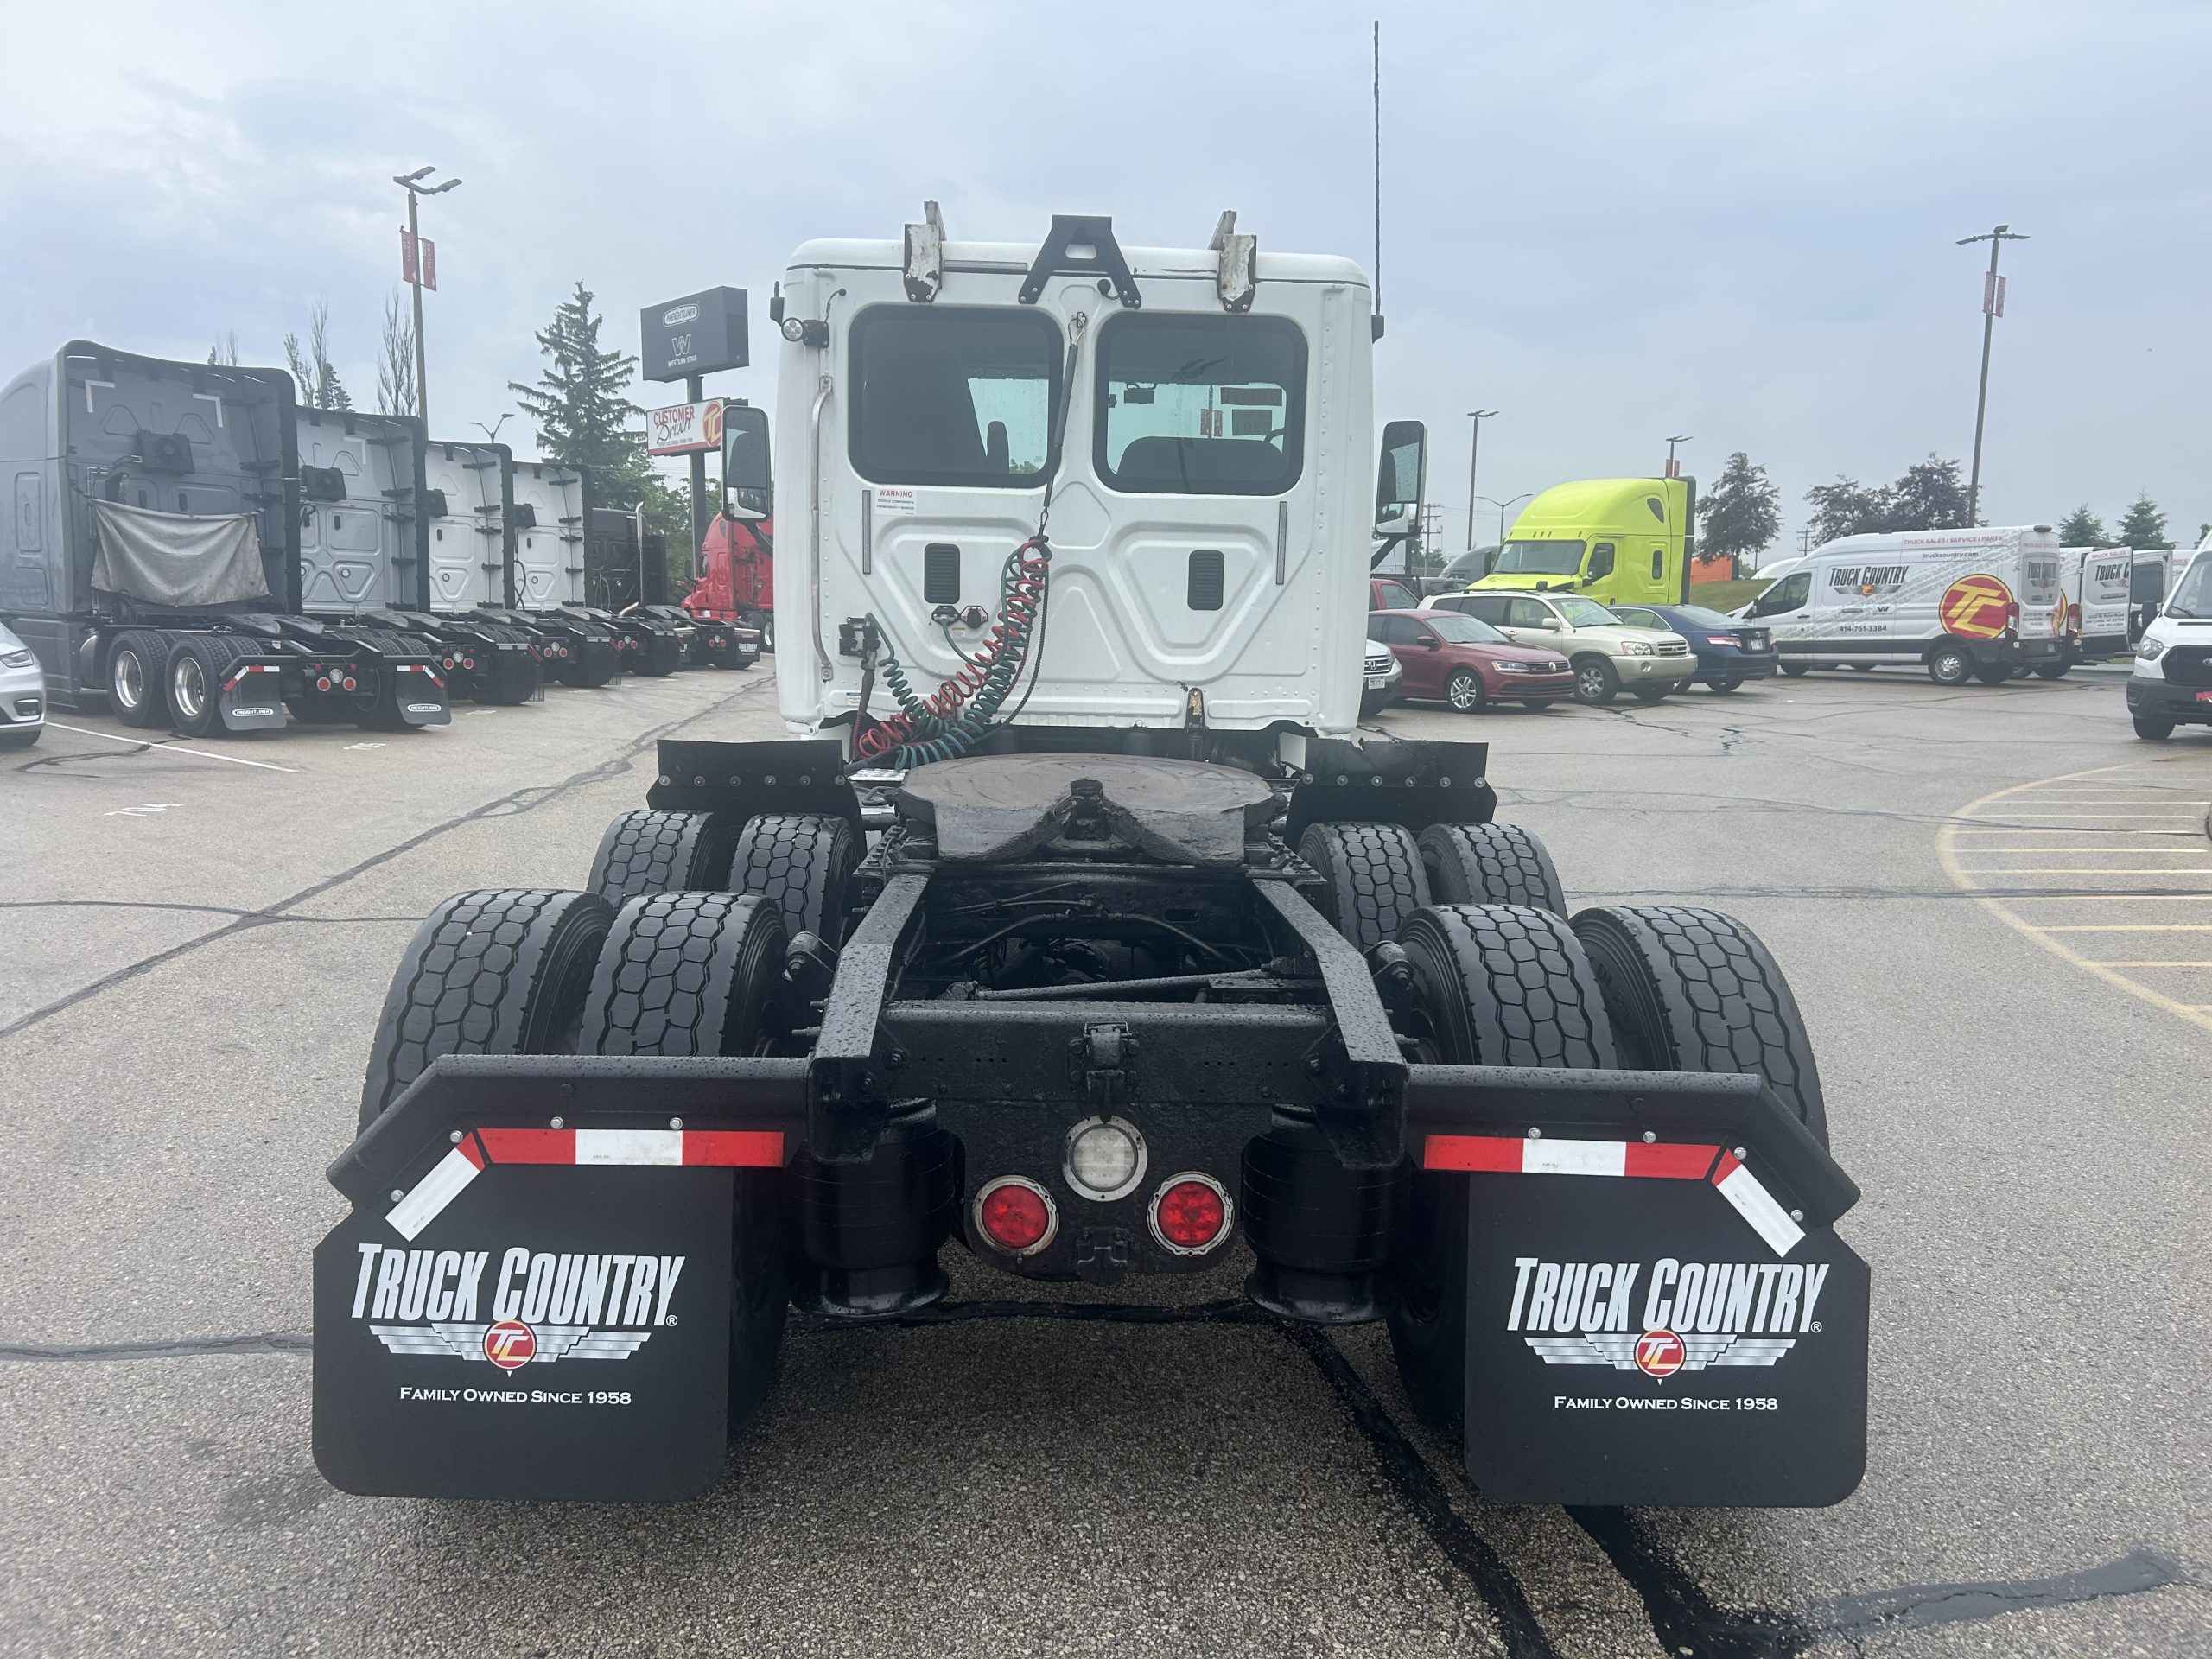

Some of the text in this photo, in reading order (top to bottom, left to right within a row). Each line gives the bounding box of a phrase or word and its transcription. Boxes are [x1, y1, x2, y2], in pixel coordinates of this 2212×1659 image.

[668, 358, 686, 367] WESTERN
[653, 405, 695, 426] CUSTOMER
[656, 419, 692, 444] Driven
[880, 489, 913, 498] WARNING
[1829, 565, 1910, 586] TRUCK COUNTRY
[2094, 563, 2123, 582] TRUCK
[352, 1243, 685, 1326] TRUCK COUNTRY
[1507, 1258, 1829, 1332] TRUCK COUNTRY
[400, 1387, 632, 1404] FAMILY OWNED SINCE 1958
[1554, 1396, 1778, 1410] FAMILY OWNED SINCE 1958
